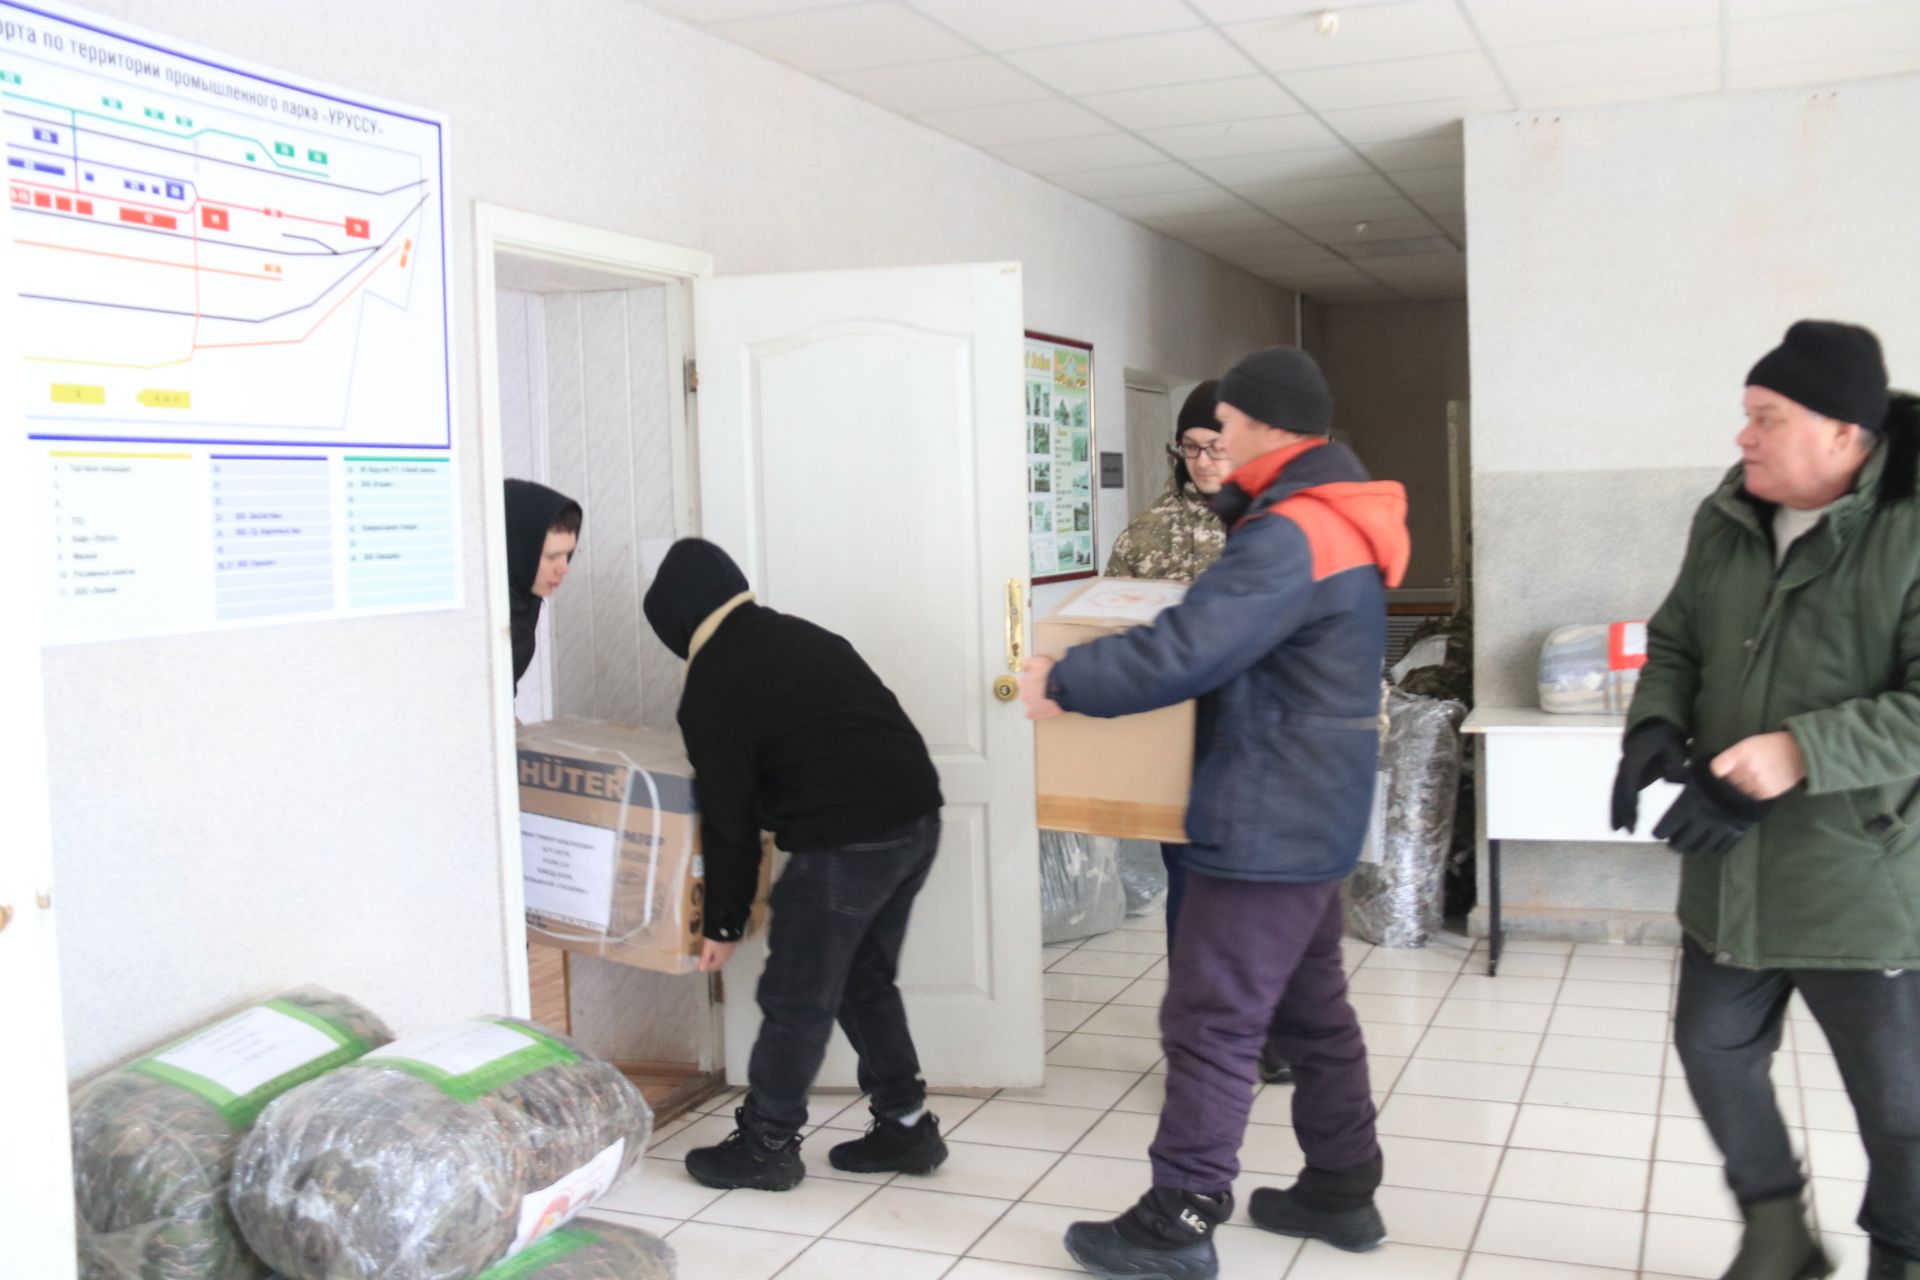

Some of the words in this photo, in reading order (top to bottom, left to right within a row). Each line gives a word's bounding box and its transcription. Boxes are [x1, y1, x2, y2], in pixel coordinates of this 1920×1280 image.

[43, 31, 63, 51] по
[70, 40, 161, 79] территории
[166, 67, 278, 111] промышленного
[282, 99, 319, 121] парка
[519, 757, 627, 800] HÜTER
